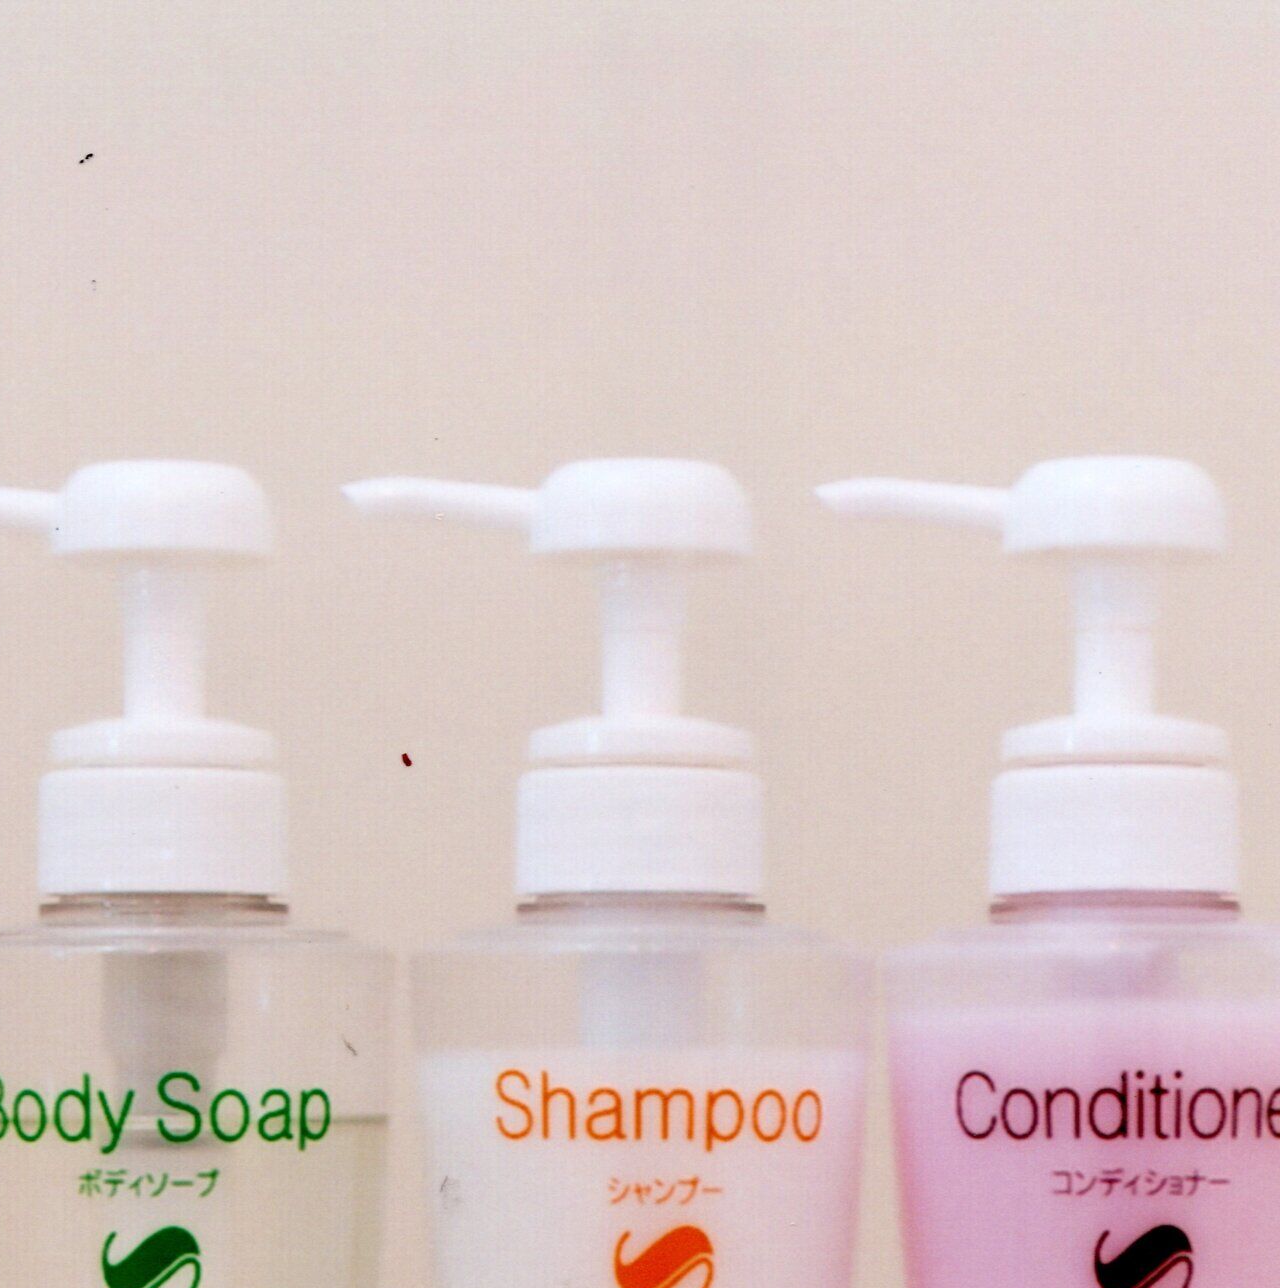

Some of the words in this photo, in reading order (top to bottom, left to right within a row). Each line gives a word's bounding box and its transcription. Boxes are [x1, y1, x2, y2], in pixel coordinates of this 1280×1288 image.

[156, 1070, 332, 1152] Soap
[494, 1068, 823, 1152] Shampoo
[77, 1167, 221, 1198] ボディソープ
[607, 1175, 724, 1205] シャンプー
[1051, 1167, 1231, 1197] コンディショナー
